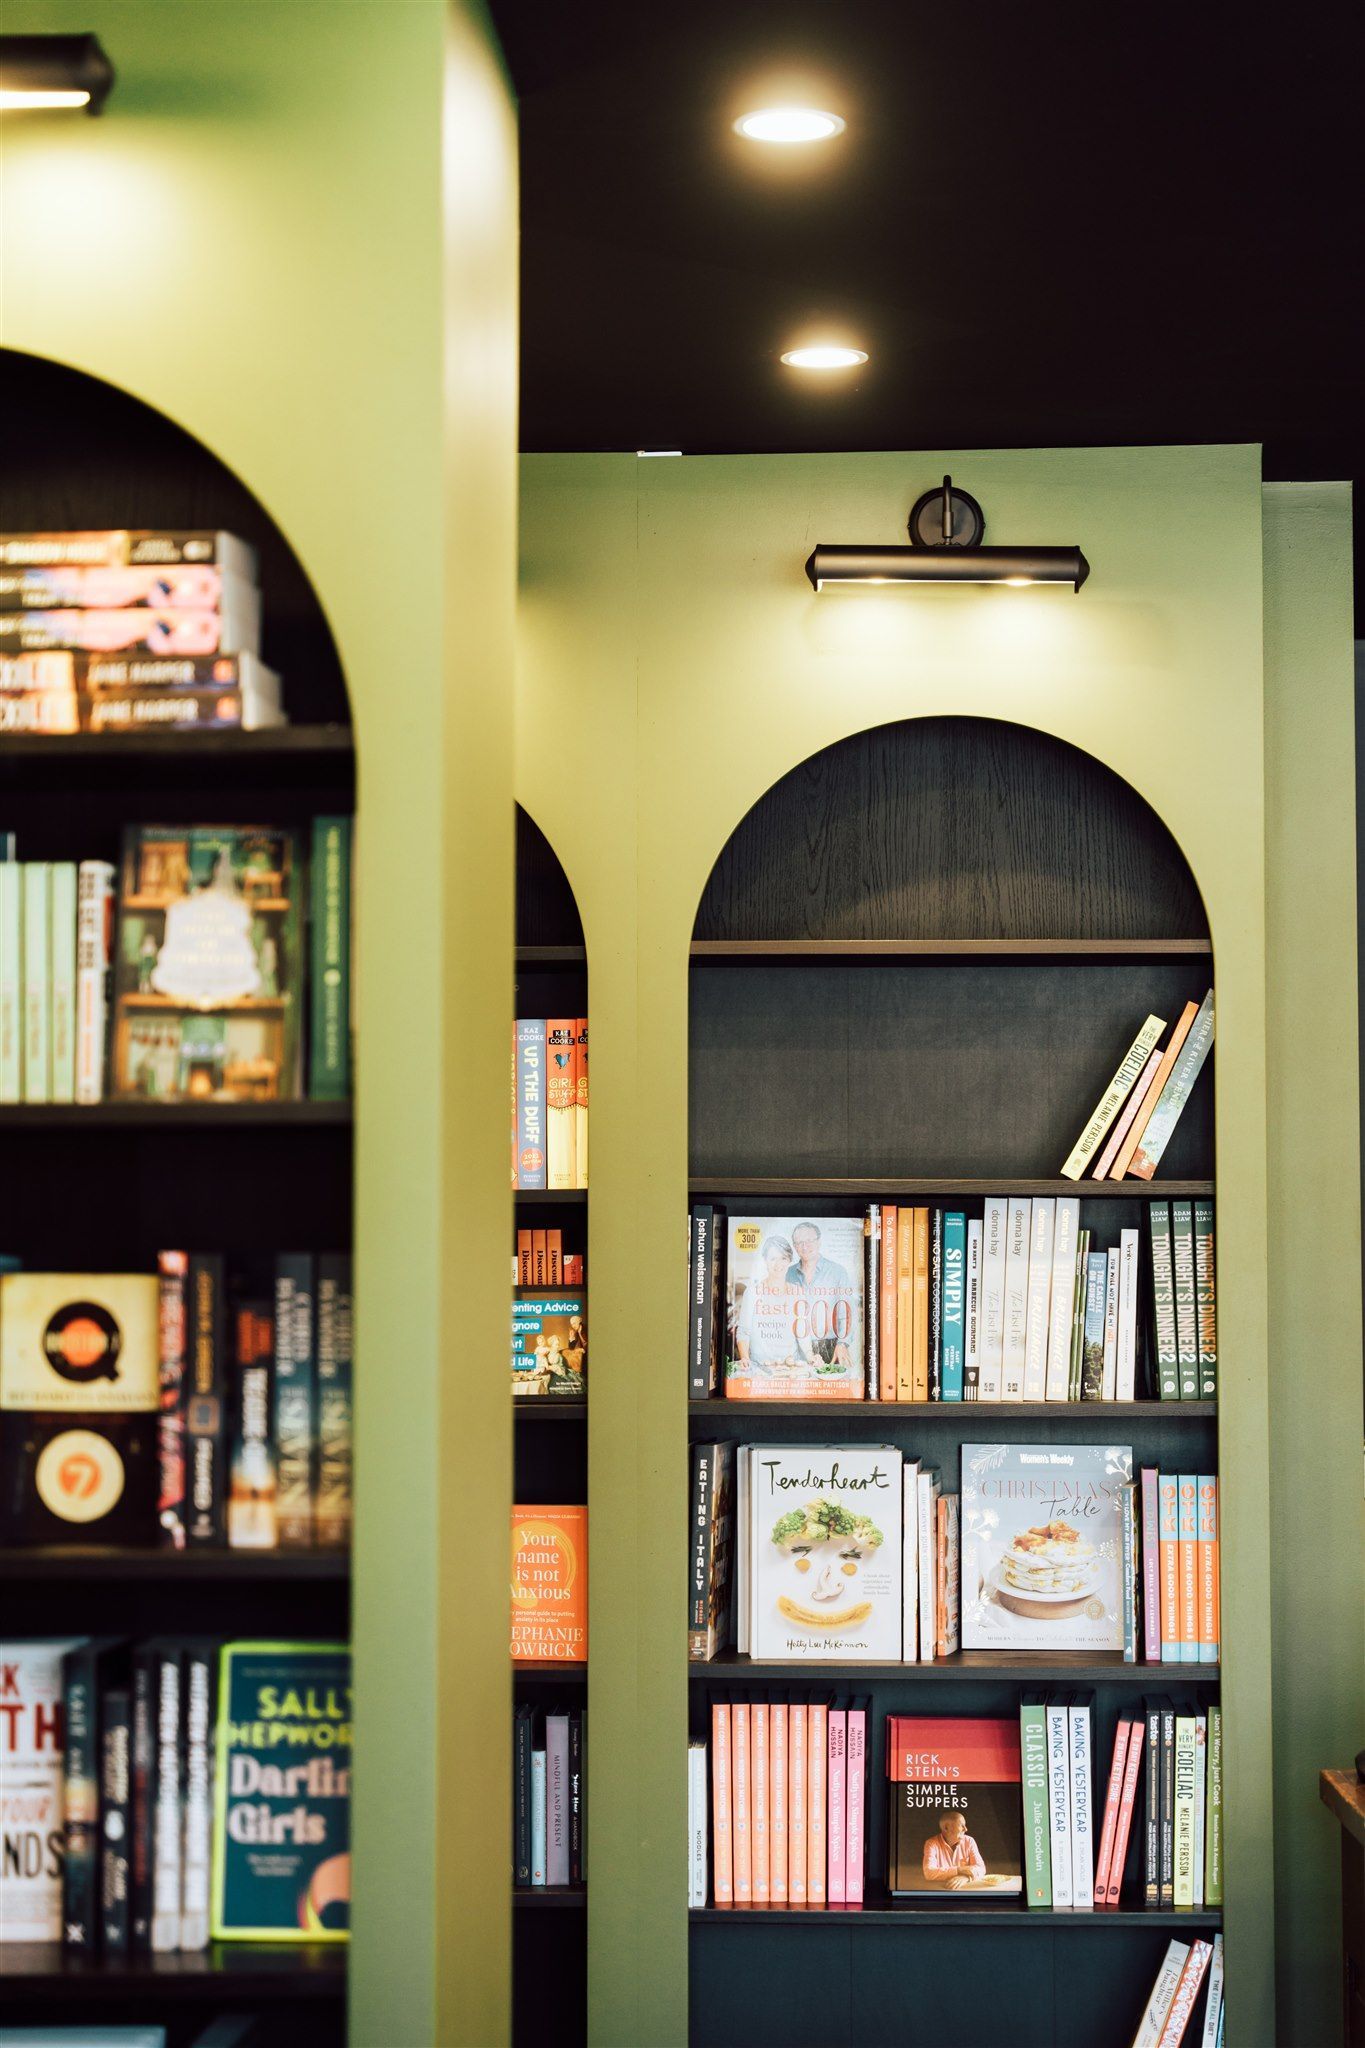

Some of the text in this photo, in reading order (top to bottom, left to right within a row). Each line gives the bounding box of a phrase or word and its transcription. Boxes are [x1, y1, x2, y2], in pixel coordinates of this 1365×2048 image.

[524, 1045, 539, 1068] UP
[524, 1071, 539, 1102] THE
[549, 1077, 575, 1089] GIRL
[549, 1088, 576, 1099] STUFF
[1166, 1050, 1198, 1110] RIVER BENDS
[1080, 1044, 1149, 1155] COELIAC MELANIE PERSSON
[524, 1107, 540, 1144] DUFF
[887, 1216, 894, 1225] To
[989, 1209, 1000, 1257] donna hay
[1013, 1209, 1024, 1257] donna hay
[1036, 1208, 1047, 1253] donna hay
[1060, 1208, 1071, 1253] donna hay
[742, 1234, 756, 1243] 300
[933, 1240, 941, 1256] NO
[696, 1218, 707, 1305] joshua weissman
[932, 1257, 941, 1280] SALT
[945, 1248, 962, 1325] SIMPLY
[1088, 1283, 1096, 1312] SUNSET
[1095, 1285, 1104, 1313] CASTLE
[1152, 1233, 1177, 1363] TONIGHT'S DINNER 2
[1174, 1233, 1197, 1363] TONIGHT'S DINNER 2
[1196, 1233, 1217, 1363] TONIGHT'S DINNER 2
[512, 1303, 579, 1314] enting Advice
[755, 1299, 852, 1339] fast 800
[932, 1282, 941, 1338] COOKBOOK
[512, 1322, 540, 1332] gnore
[757, 1320, 787, 1329] recipe
[761, 1331, 783, 1339] book
[518, 1357, 534, 1365] Life
[1020, 1453, 1074, 1466] Women's Weekly
[761, 1461, 890, 1495] Tenderheart
[981, 1479, 1111, 1500] CHRISTMAS
[697, 1459, 708, 1526] EATING
[1040, 1497, 1101, 1518] Table
[520, 1530, 556, 1546] Your
[517, 1551, 559, 1564] name
[696, 1535, 706, 1590] ITALY
[517, 1566, 559, 1581] is not
[1167, 1544, 1175, 1633] EXTRA GOOD THINGS
[1205, 1544, 1213, 1633] EXTRA GOOD THINGS
[512, 1627, 583, 1641] EPHANIE
[510, 1642, 576, 1657] OWRICK
[258, 1686, 351, 1718] SALL
[1150, 1715, 1158, 1740] taste
[1165, 1715, 1173, 1740] taste
[906, 1754, 939, 1764] RICK
[906, 1767, 960, 1777] STEIN'S
[231, 1755, 351, 1797] Darli
[1052, 1717, 1065, 1832] BAKING YESTERYEAR
[1074, 1717, 1087, 1833] BAKING YESTERYEAR
[1109, 1762, 1123, 1803] KETO CURE
[1123, 1762, 1137, 1804] KETO CURE
[906, 1784, 957, 1795] SIMPLE
[906, 1797, 968, 1808] SUPPERS
[1026, 1724, 1045, 1871] CLASSIC Julie Goodwin
[1213, 1784, 1221, 1806] Cook
[229, 1803, 327, 1845] Girls
[831, 1805, 840, 1833] Simple
[850, 1807, 859, 1834] Simple
[1177, 1750, 1194, 1877] COELIAC MELANIE PERSSON
[832, 1835, 840, 1862] Spices
[850, 1836, 859, 1863] Spices
[1156, 1969, 1172, 2004] Daughter
[1207, 2022, 1215, 2037] DIET
